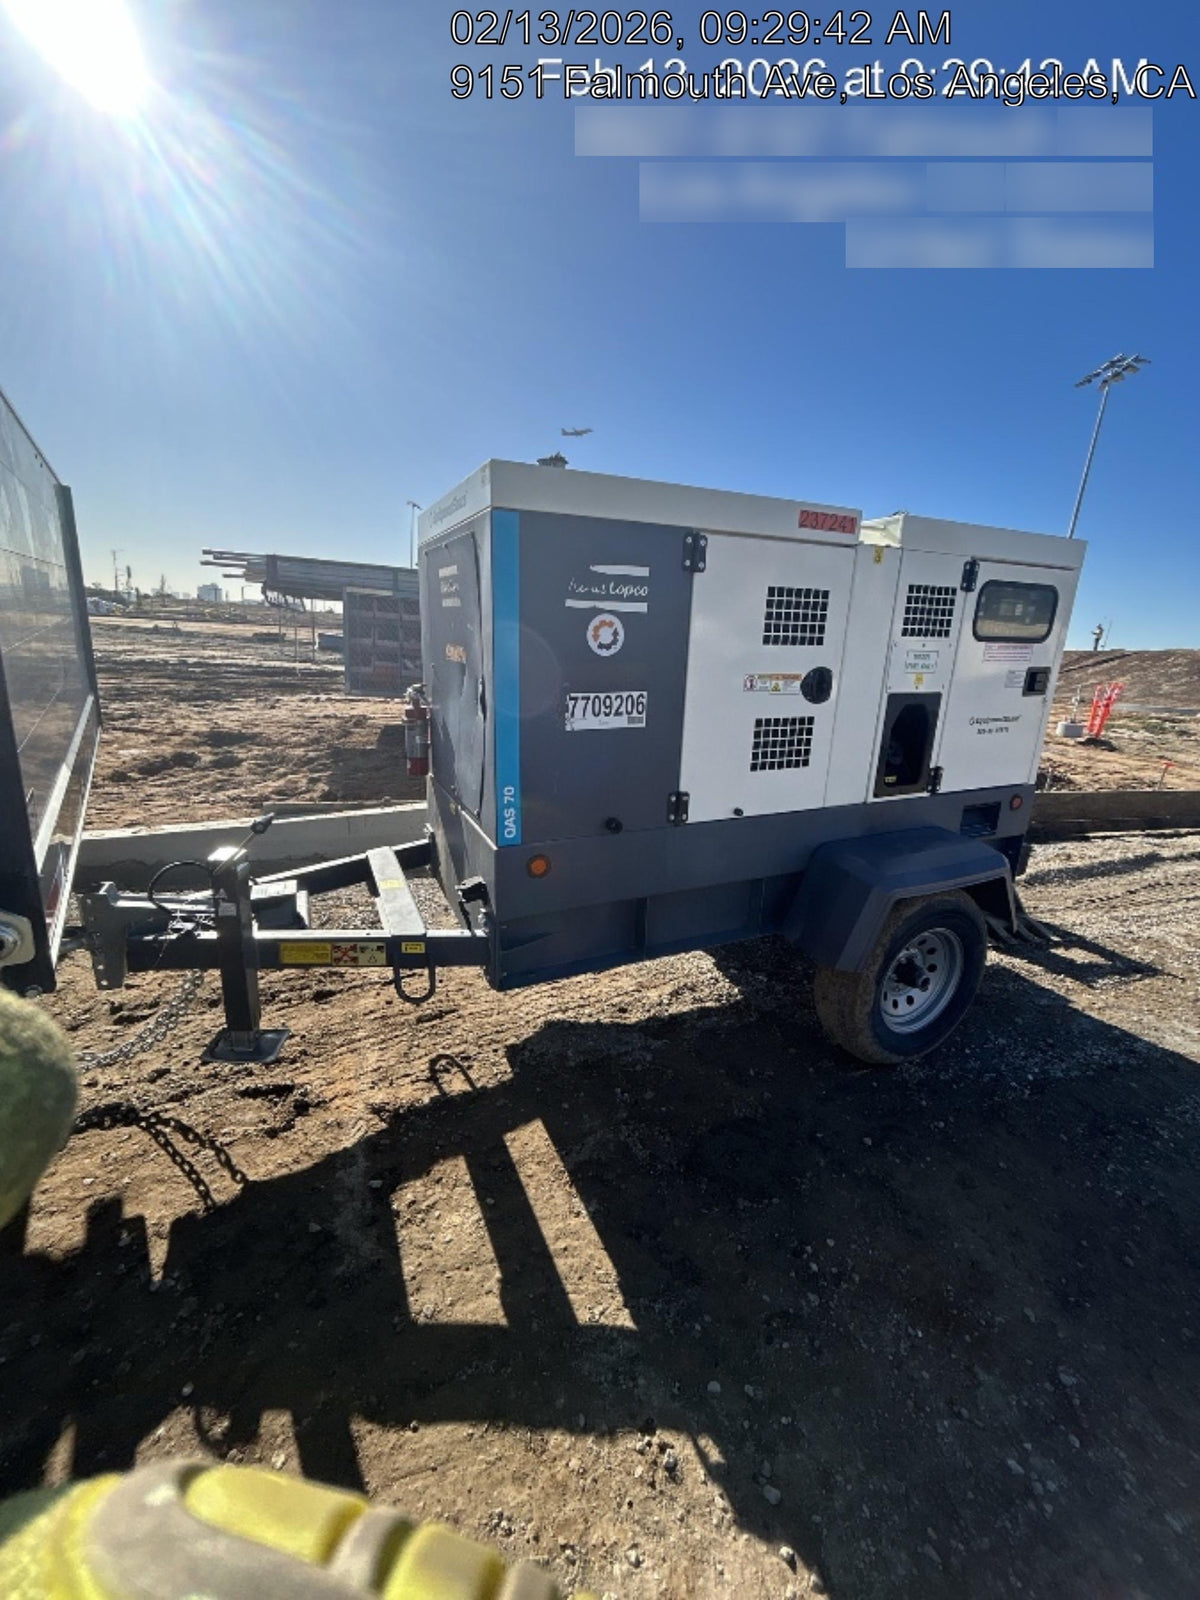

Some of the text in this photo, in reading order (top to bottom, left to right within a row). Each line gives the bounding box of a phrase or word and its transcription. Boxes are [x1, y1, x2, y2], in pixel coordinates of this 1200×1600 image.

[569, 693, 645, 717] 7709206
[503, 785, 517, 839] QAS 70
